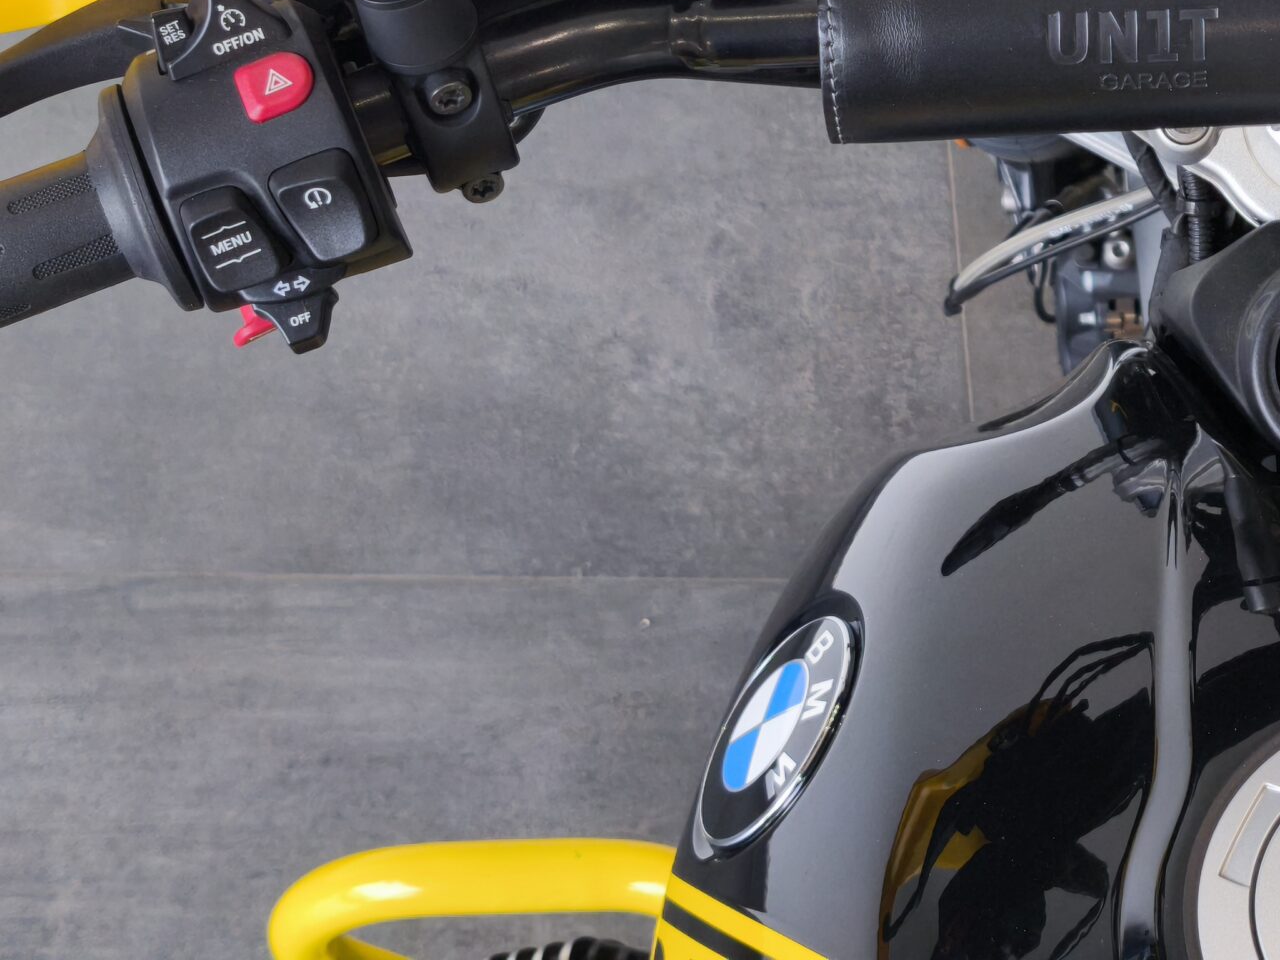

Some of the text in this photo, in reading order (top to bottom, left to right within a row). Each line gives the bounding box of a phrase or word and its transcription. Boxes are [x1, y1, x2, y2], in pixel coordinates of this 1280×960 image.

[159, 20, 180, 36] SET
[164, 29, 186, 46] RES
[212, 27, 266, 56] OFF/ON
[1100, 70, 1209, 91] GARAGE
[209, 230, 253, 257] MENU
[289, 311, 312, 327] OFF
[764, 630, 834, 800] BMW
